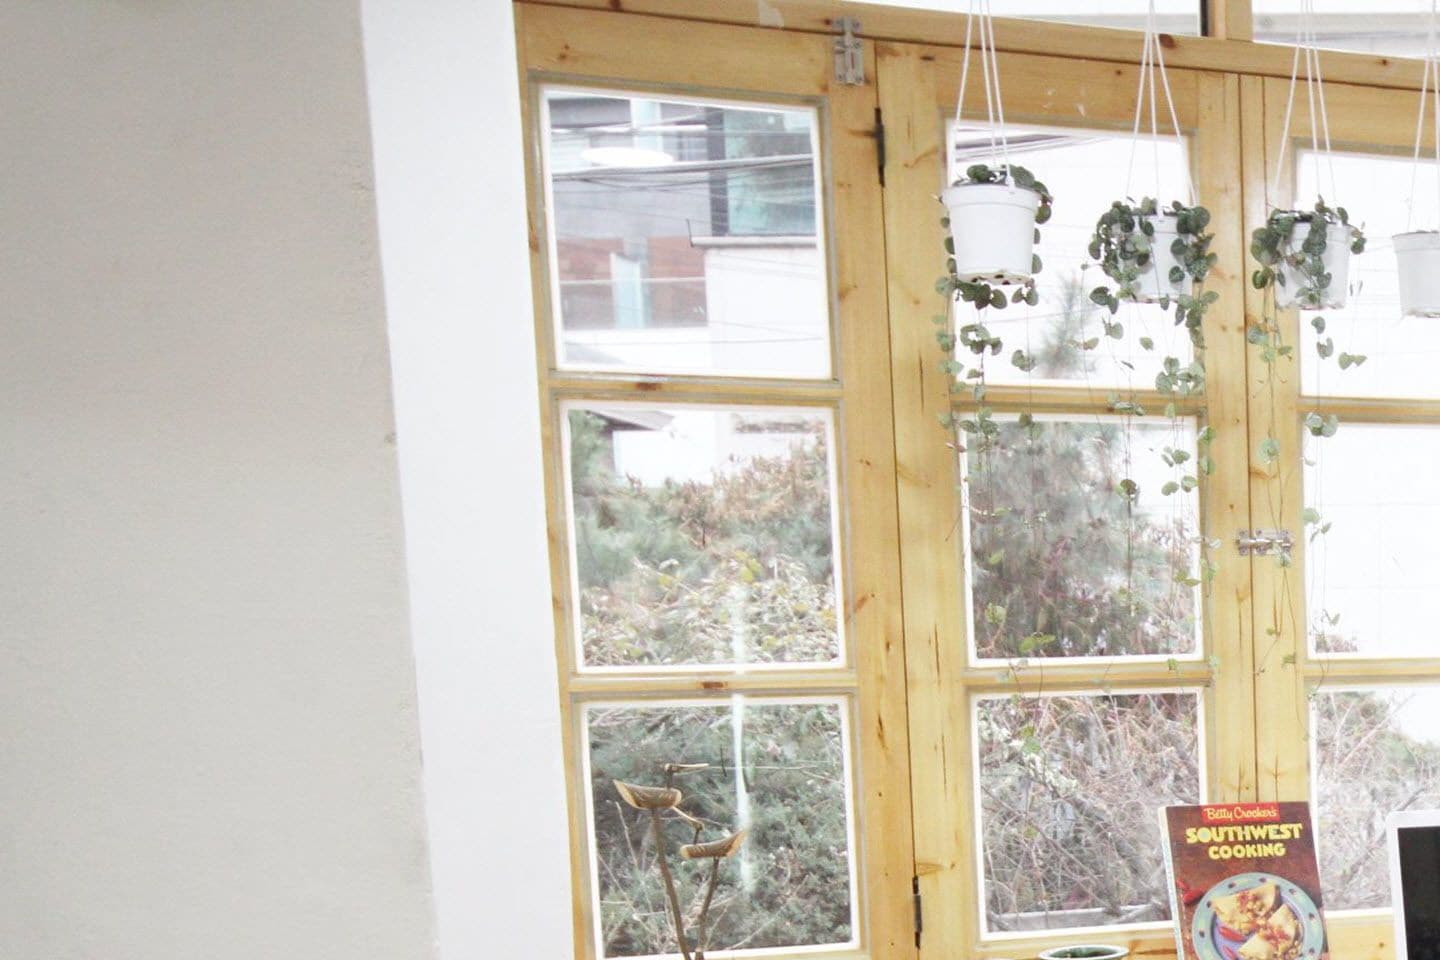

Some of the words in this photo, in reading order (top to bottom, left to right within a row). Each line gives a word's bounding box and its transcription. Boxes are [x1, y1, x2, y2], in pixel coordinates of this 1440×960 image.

[1203, 807, 1232, 821] Betty
[1233, 806, 1277, 819] Crocker's
[1185, 823, 1303, 844] SOUTHWEST
[1208, 843, 1286, 860] COOKING
